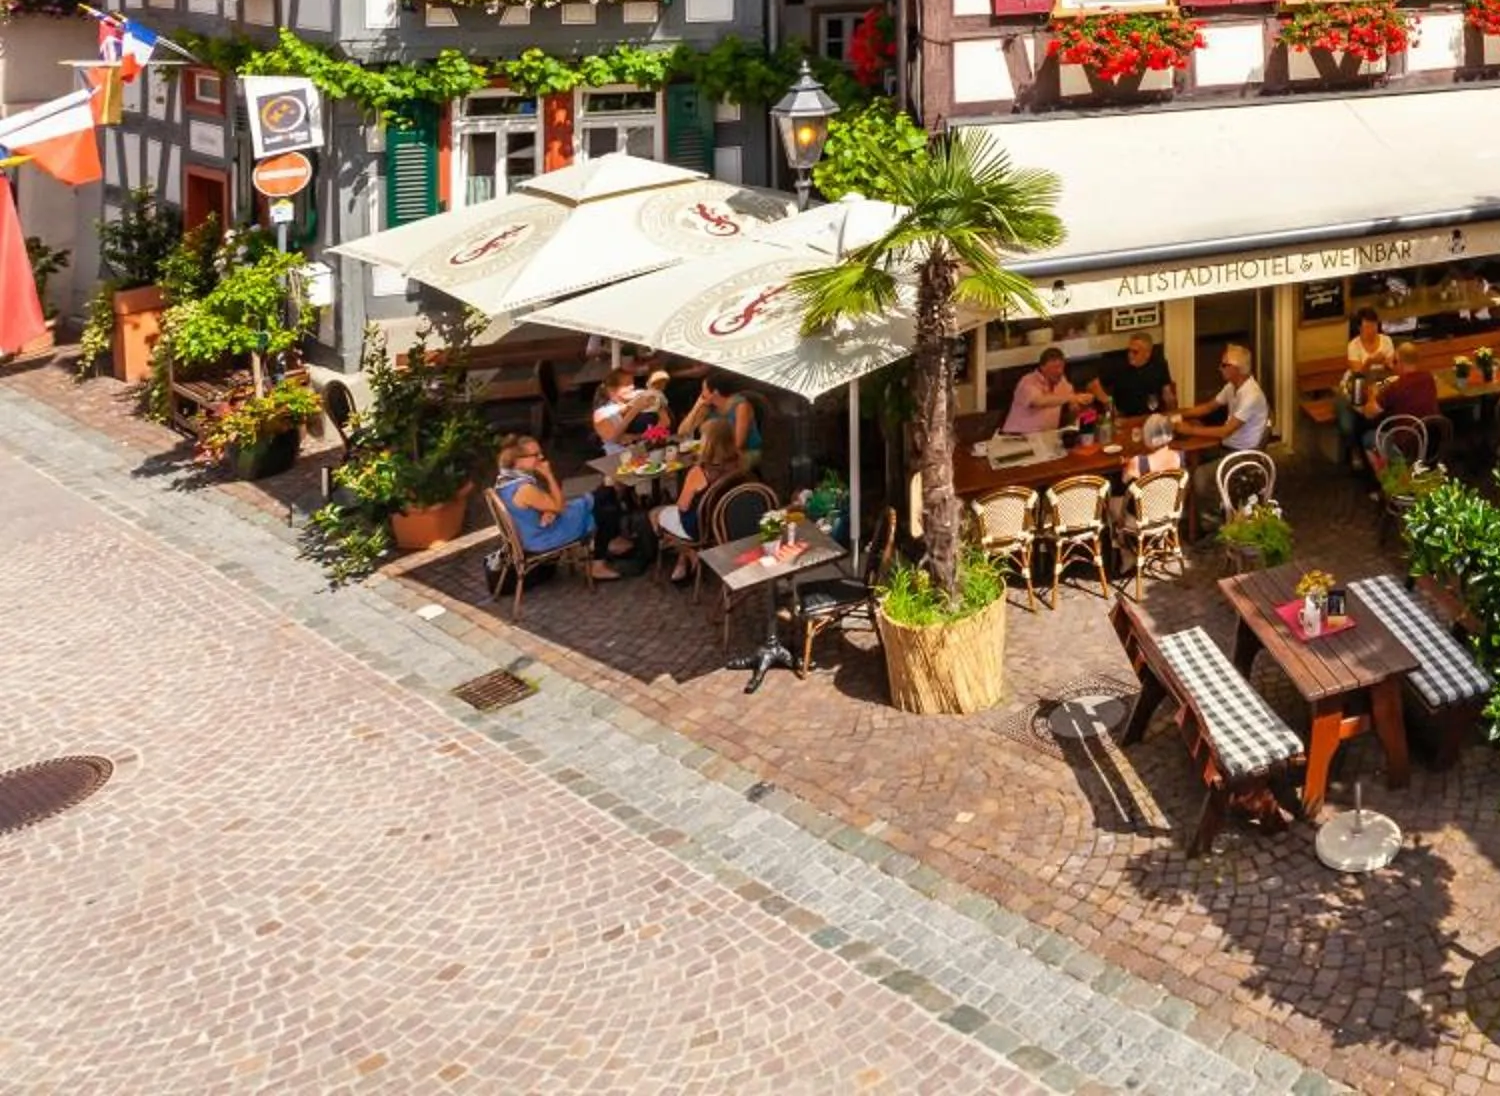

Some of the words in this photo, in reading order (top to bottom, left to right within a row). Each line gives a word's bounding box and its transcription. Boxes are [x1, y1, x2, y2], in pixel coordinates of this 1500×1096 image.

[1117, 255, 1294, 297] ALTSTADTHOTEL
[1299, 254, 1313, 272] &
[1320, 240, 1412, 268] WEINBAR
